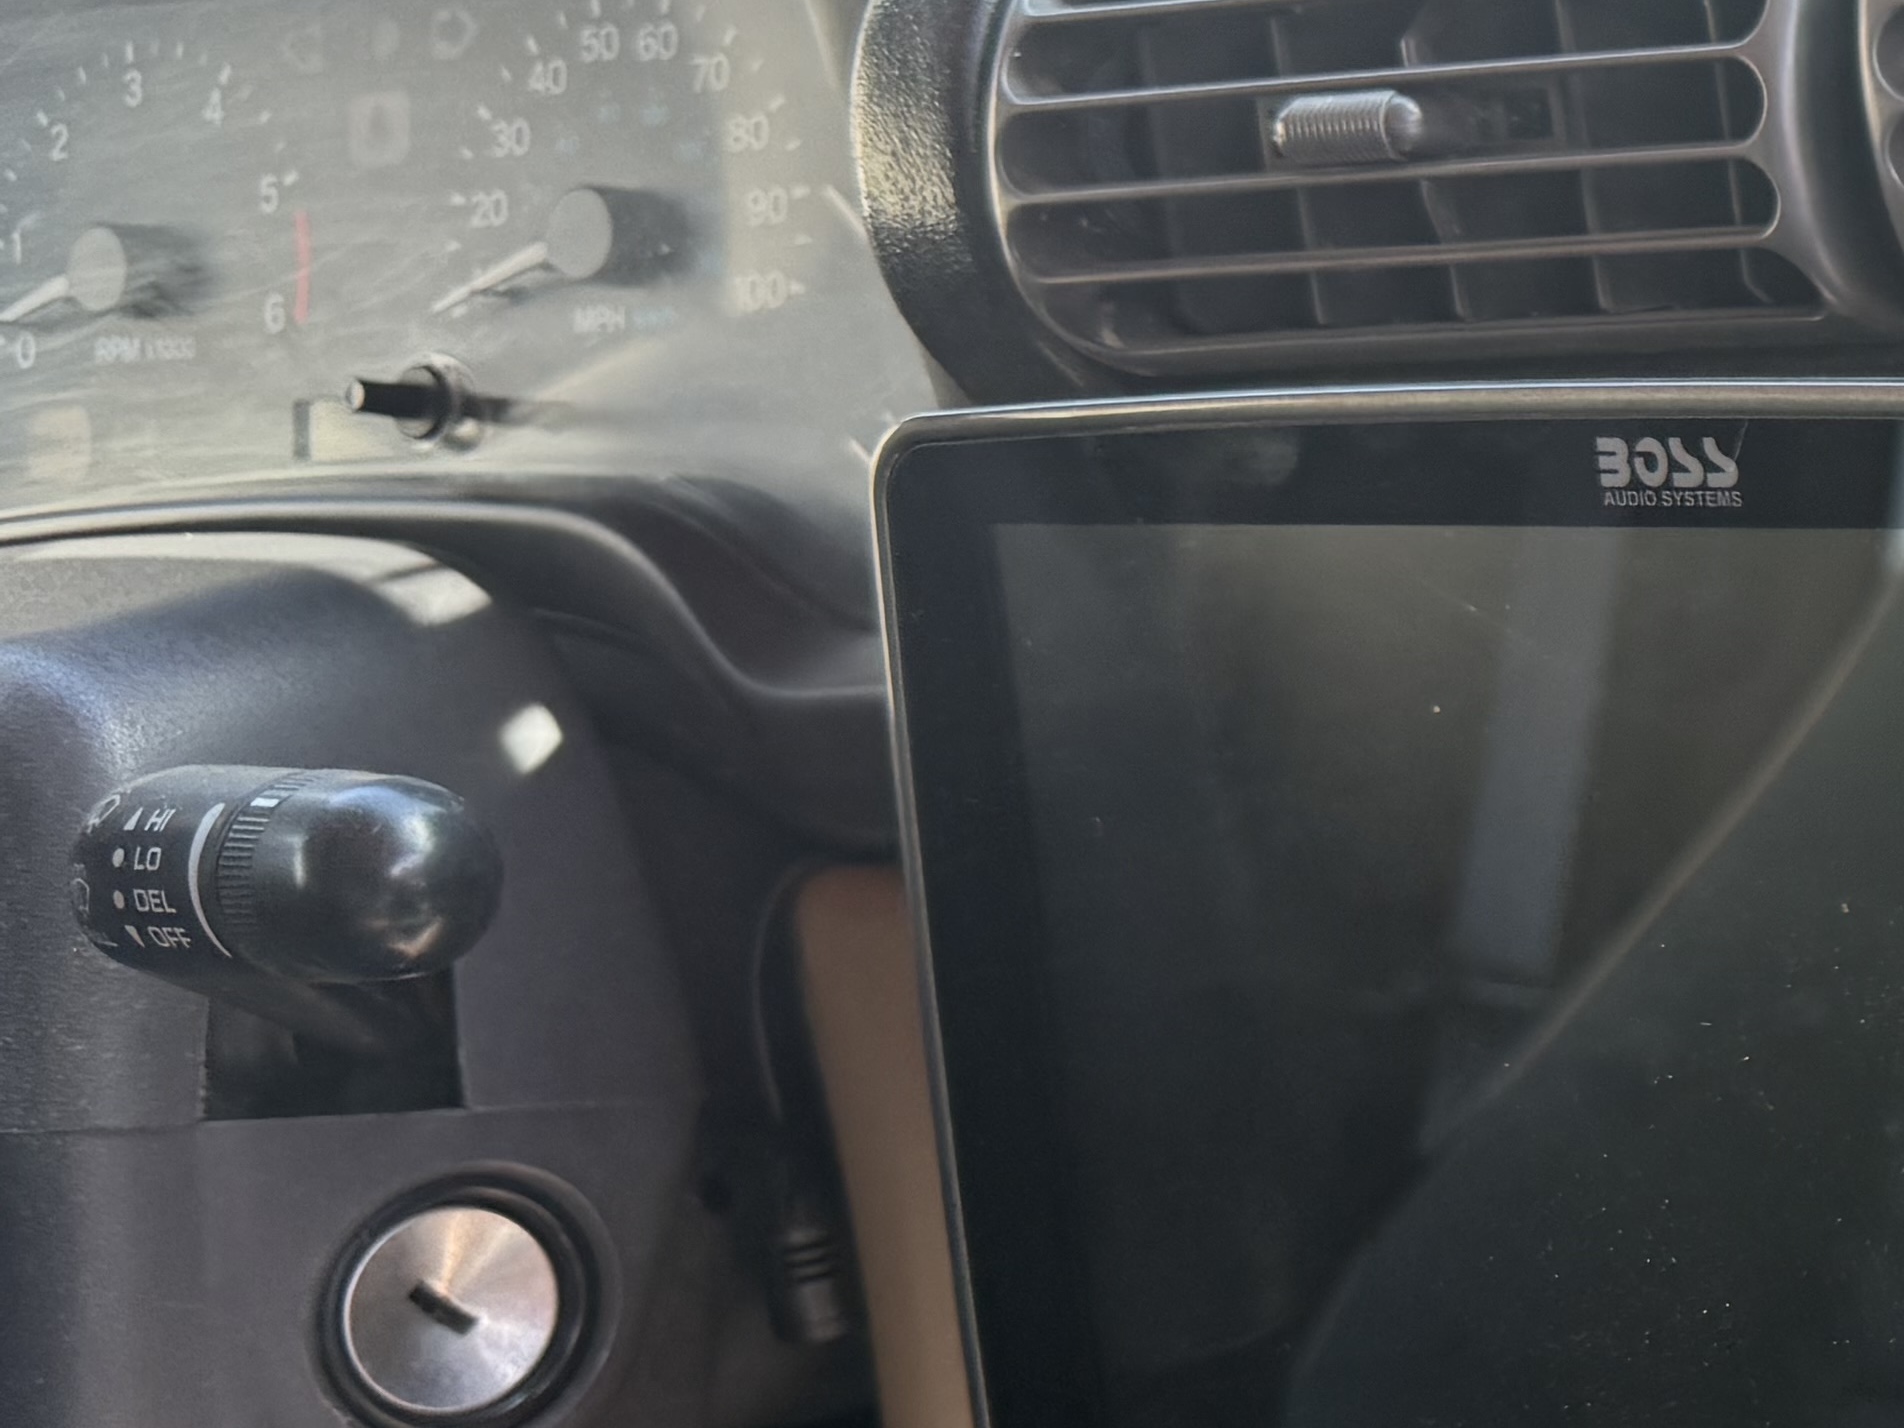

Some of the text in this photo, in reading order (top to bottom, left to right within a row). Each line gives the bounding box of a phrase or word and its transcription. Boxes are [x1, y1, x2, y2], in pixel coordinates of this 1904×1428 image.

[580, 22, 621, 62] 50
[637, 21, 679, 62] 60
[123, 69, 143, 108] 3
[528, 59, 568, 95] 40
[689, 52, 731, 93] 70
[202, 87, 225, 126] 4
[50, 123, 69, 161] 2
[490, 118, 531, 157] 30
[724, 114, 770, 152] 80
[259, 174, 279, 214] 5
[471, 189, 509, 228] 20
[264, 292, 287, 335] 6
[15, 331, 36, 370] 0
[1596, 437, 1739, 488] BOSS
[1604, 489, 1743, 508] AUDIO SYSTEMS
[144, 807, 176, 833] HI
[133, 847, 162, 871] LO
[133, 888, 177, 914] DEL
[148, 925, 192, 949] OFF
